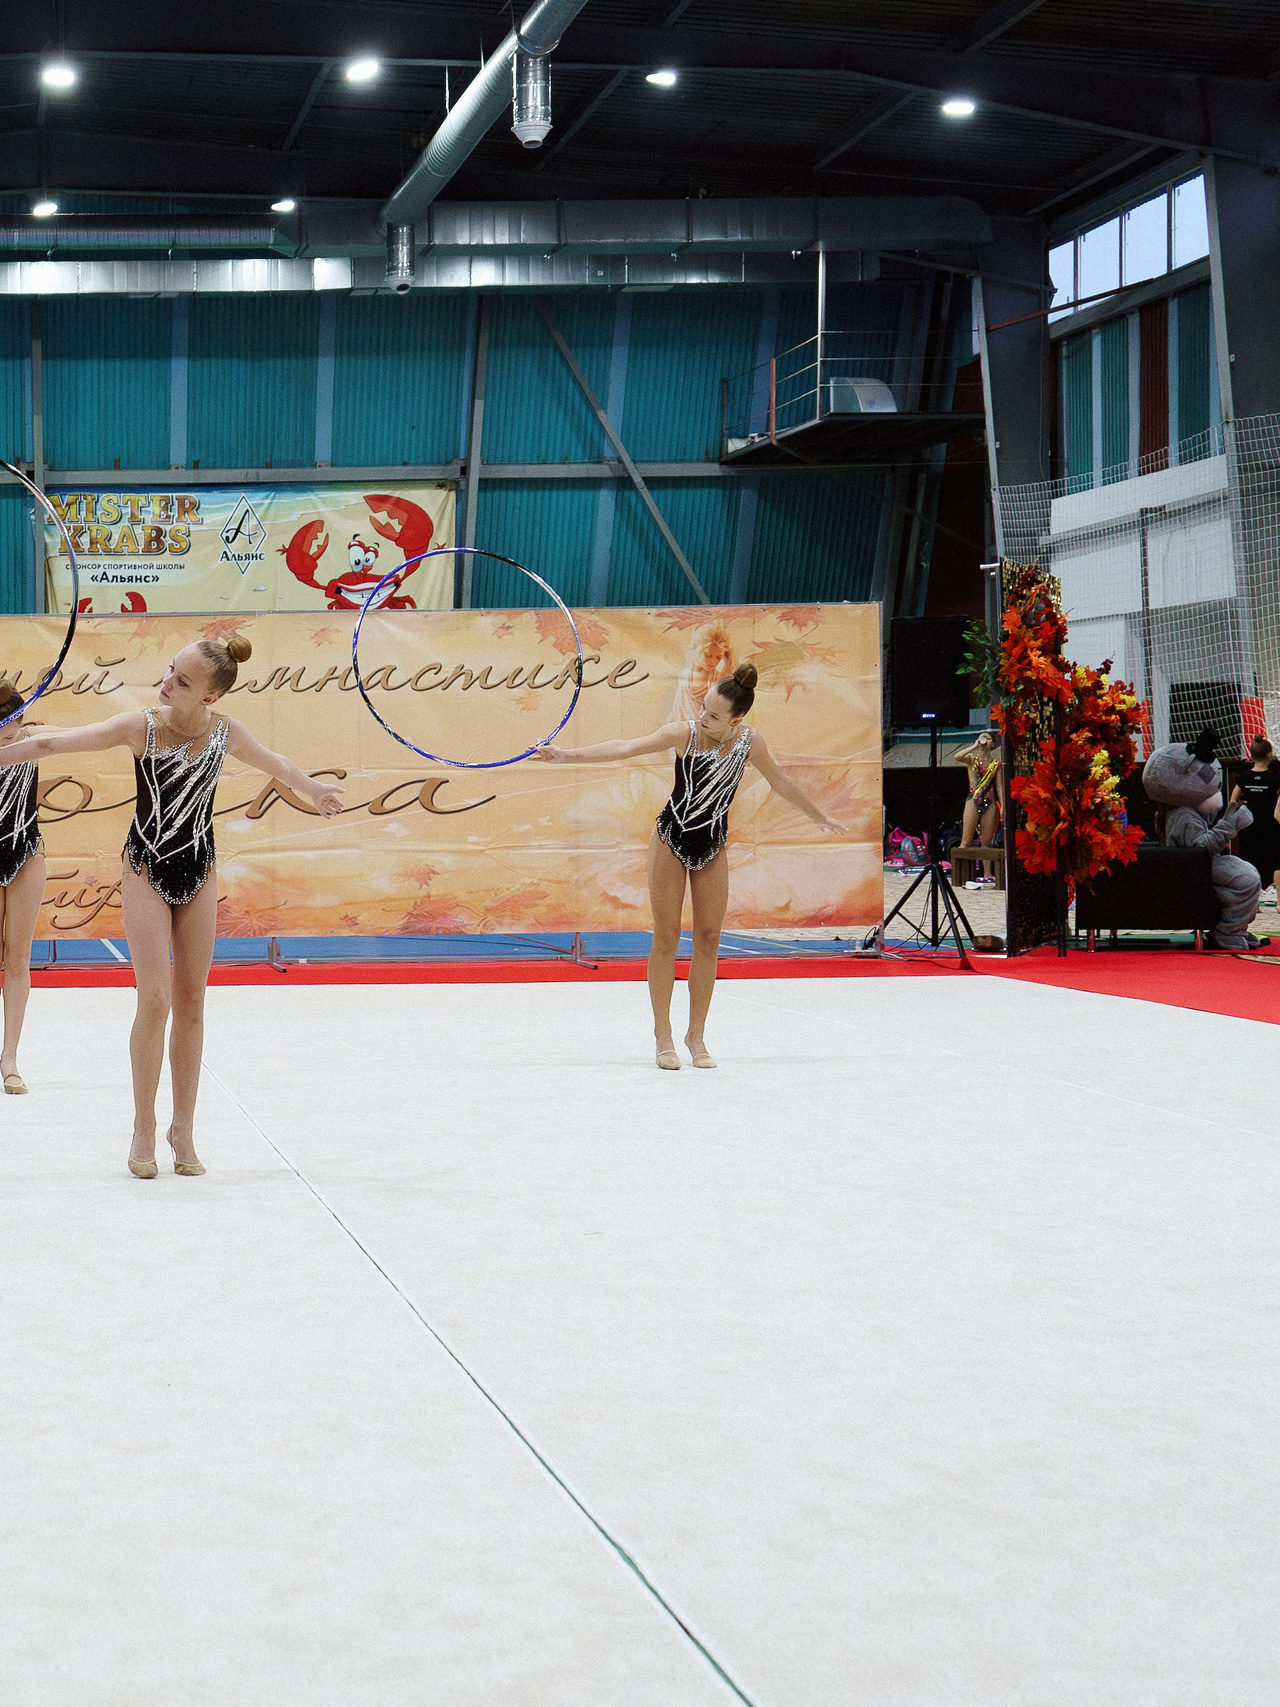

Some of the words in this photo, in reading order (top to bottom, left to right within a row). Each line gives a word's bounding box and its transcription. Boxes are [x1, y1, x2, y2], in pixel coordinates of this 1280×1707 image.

[45, 493, 203, 525] MISTER
[58, 524, 191, 555] KRABS
[65, 562, 101, 570] СОНСОР
[102, 562, 154, 570] СПОРТИВНОЙ
[155, 562, 186, 570] ШКОЛЫ
[220, 550, 266, 562] Альянс
[90, 571, 160, 583] «Альянс»
[153, 653, 650, 693] мнастике
